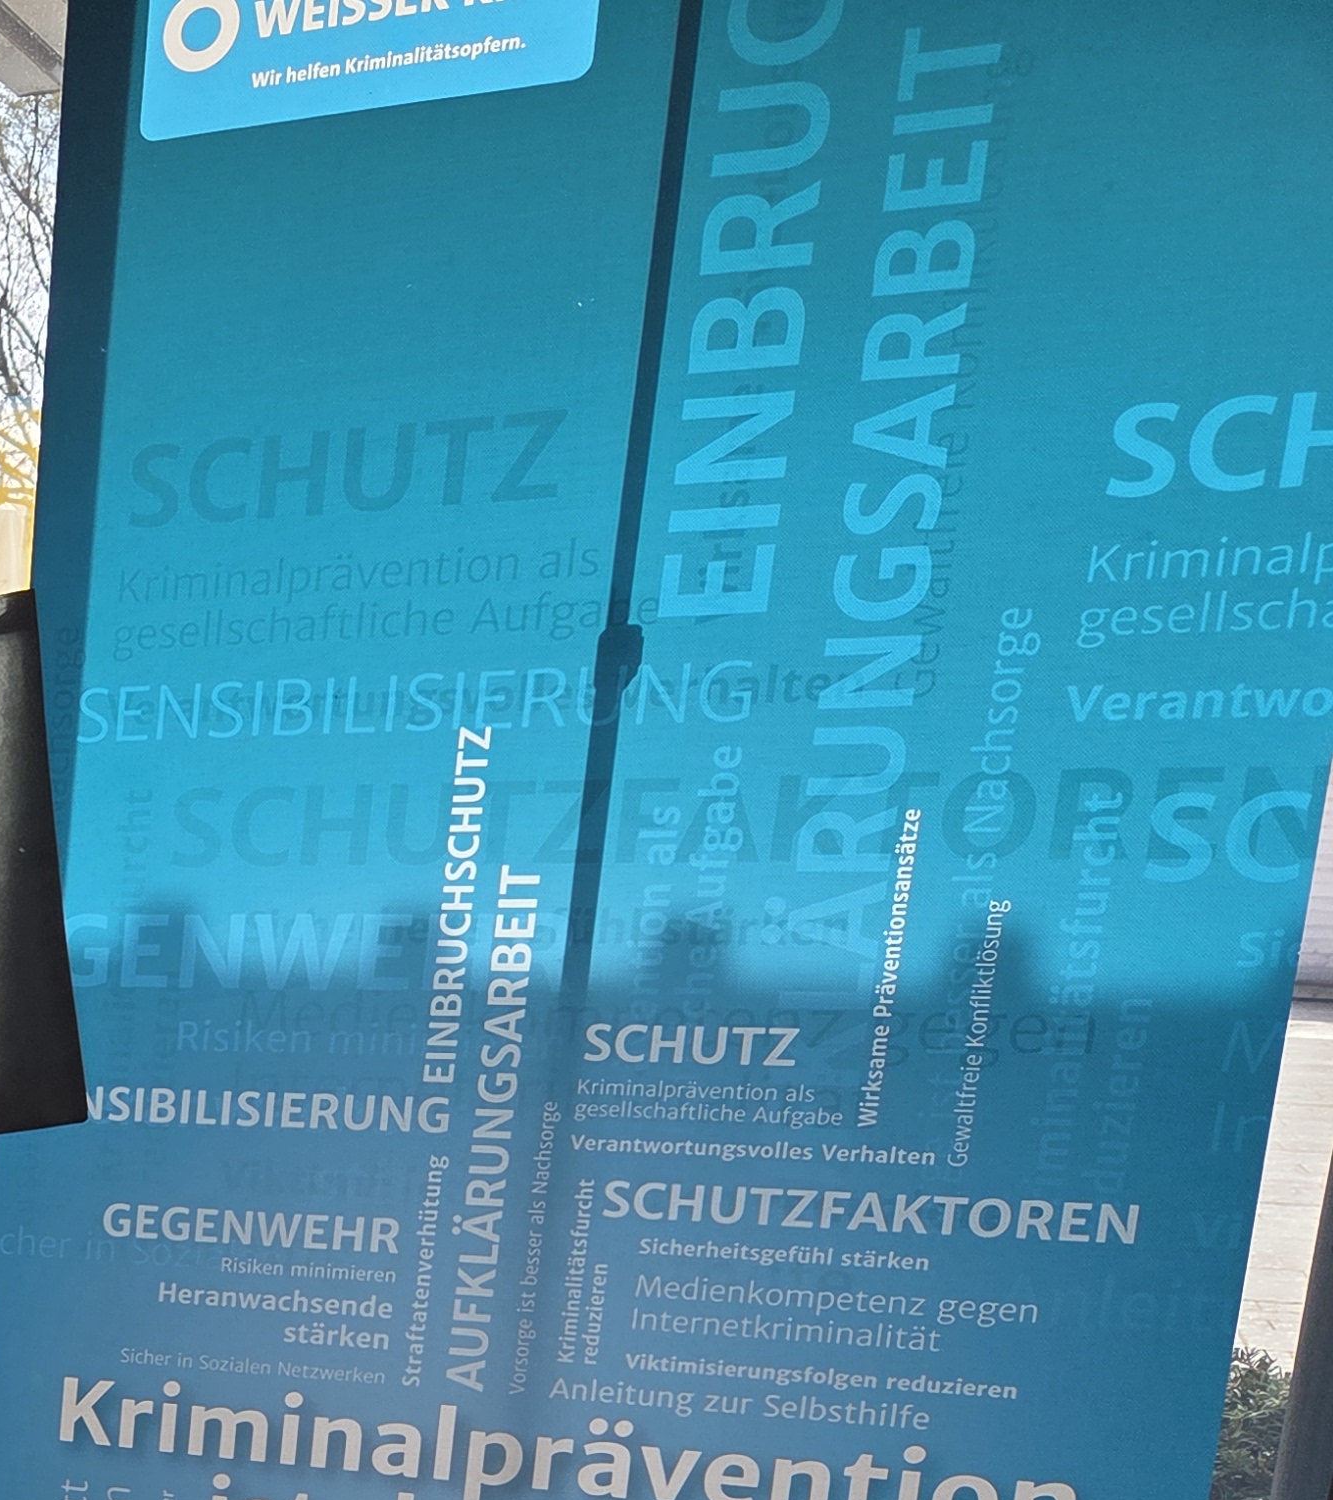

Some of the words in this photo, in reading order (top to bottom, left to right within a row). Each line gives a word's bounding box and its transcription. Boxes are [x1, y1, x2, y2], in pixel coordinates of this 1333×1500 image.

[251, 70, 281, 88] Wir
[286, 62, 340, 85] helfen
[344, 36, 526, 77] Kriminalitätsopfern.
[423, 726, 493, 1083] EINBRUCHSCHUTZ
[873, 807, 922, 1017] Präventionsansätze
[583, 1023, 801, 1067] SCHUTZ
[946, 1048, 984, 1169] Gewaltfreie
[965, 899, 1012, 1049] Konfliktlösung
[576, 1079, 779, 1105] Kriminalprävention
[785, 1085, 816, 1104] als
[856, 1016, 891, 1129] Wirksame
[87, 1085, 450, 1134] NSIBILISIERUNG
[445, 864, 541, 1392] AUFKLÄRUNGSARBEIT
[573, 1100, 747, 1124] gesellschaftliche
[752, 1106, 844, 1130] Aufgabe
[570, 1134, 814, 1162] Verantwortungsvolles
[821, 1143, 936, 1166] Verhalten
[103, 1201, 400, 1255] GEGENWEHR
[602, 1179, 1141, 1246] SCHUTZFAKTOREN
[221, 1257, 284, 1277] Risiken
[290, 1262, 397, 1283] minimieren
[401, 1155, 449, 1387] Straftatenverhütung
[556, 1179, 596, 1365] Kriminalitätsfurcht
[638, 1237, 834, 1267] Sicherheitsgefühl
[840, 1250, 930, 1272] stärken
[158, 1282, 394, 1320] Heranwachsende
[583, 1262, 609, 1366] reduzieren
[634, 1274, 928, 1317] Medienkompetenz
[936, 1297, 1039, 1329] gegen
[284, 1323, 390, 1351] stärken
[631, 1308, 942, 1353] Internetkriminalität
[625, 1353, 878, 1391] Viktimisierungsfolgen
[886, 1373, 1018, 1400] reduzieren
[549, 1377, 694, 1417] Anleitung
[703, 1393, 754, 1415] zur
[763, 1394, 930, 1431] Selbsthilfe
